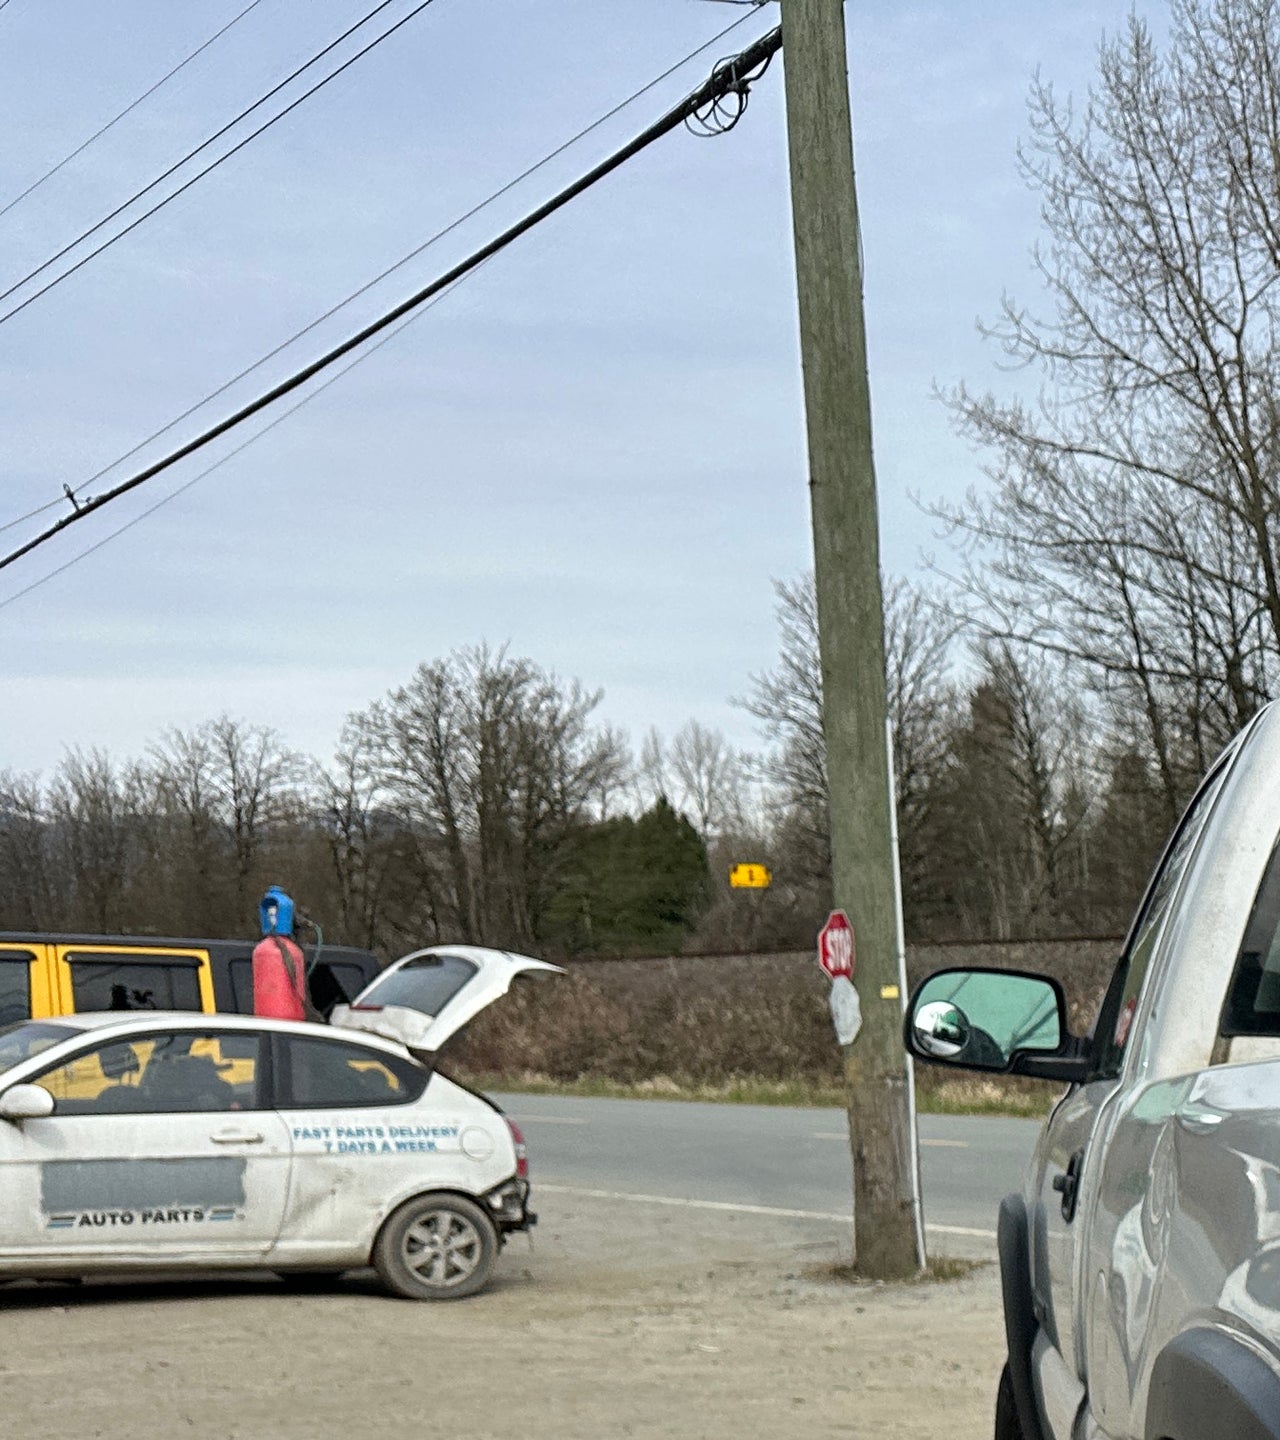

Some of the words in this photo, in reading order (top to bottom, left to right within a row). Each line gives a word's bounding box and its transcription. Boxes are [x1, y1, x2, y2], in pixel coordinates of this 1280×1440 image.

[826, 928, 852, 970] STOP
[293, 1127, 331, 1139] FAST
[336, 1127, 385, 1138] PARTS
[388, 1126, 459, 1138] DELIVERY
[324, 1141, 333, 1153] 7
[338, 1140, 376, 1153] DAYS
[381, 1141, 391, 1152] A
[395, 1140, 437, 1151] WEEK
[79, 1212, 134, 1227] AUTO
[141, 1209, 204, 1224] PARTS
